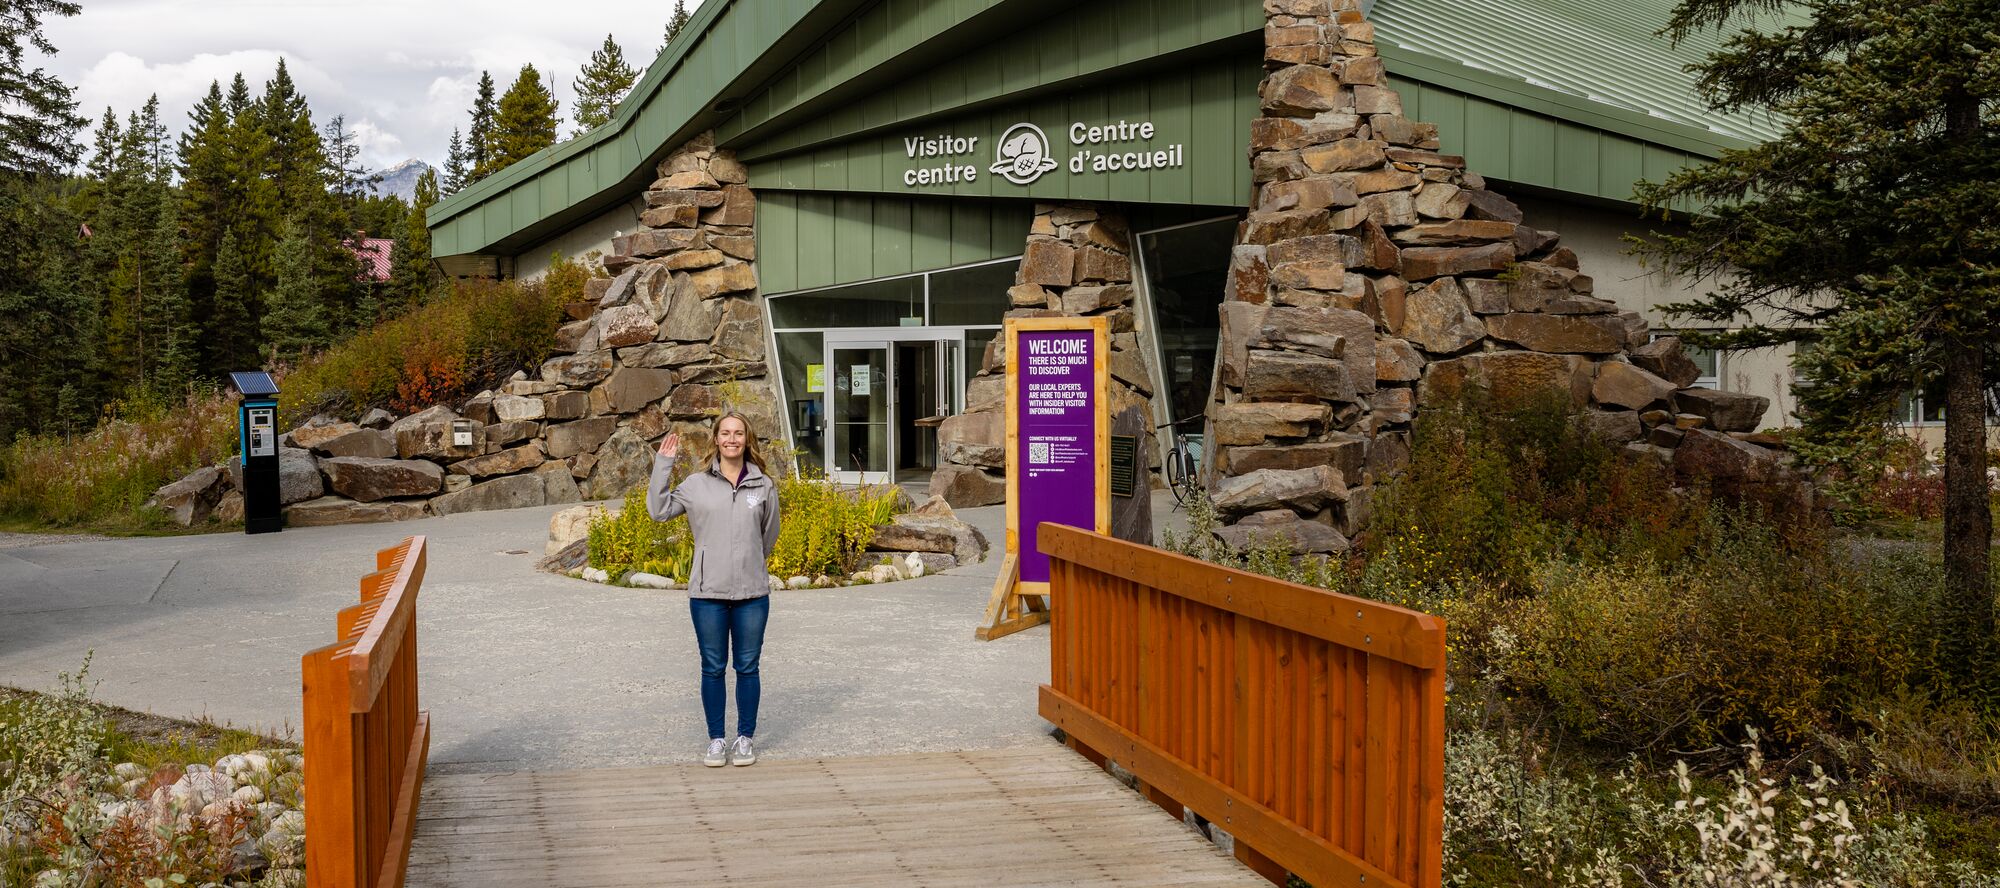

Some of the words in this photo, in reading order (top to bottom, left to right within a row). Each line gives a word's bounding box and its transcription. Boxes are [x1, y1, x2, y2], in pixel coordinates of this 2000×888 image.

[1069, 120, 1155, 145] Centre
[904, 134, 978, 158] Visitor
[1069, 144, 1184, 173] d'accueil
[904, 162, 977, 186] centre
[1028, 340, 1087, 354] WELCOME
[1028, 356, 1048, 365] THERE
[1050, 356, 1057, 365] IS
[1058, 356, 1066, 365] SO
[1068, 356, 1087, 364] MUCH
[1029, 366, 1038, 375] TO
[1039, 366, 1070, 375] DISCOVER
